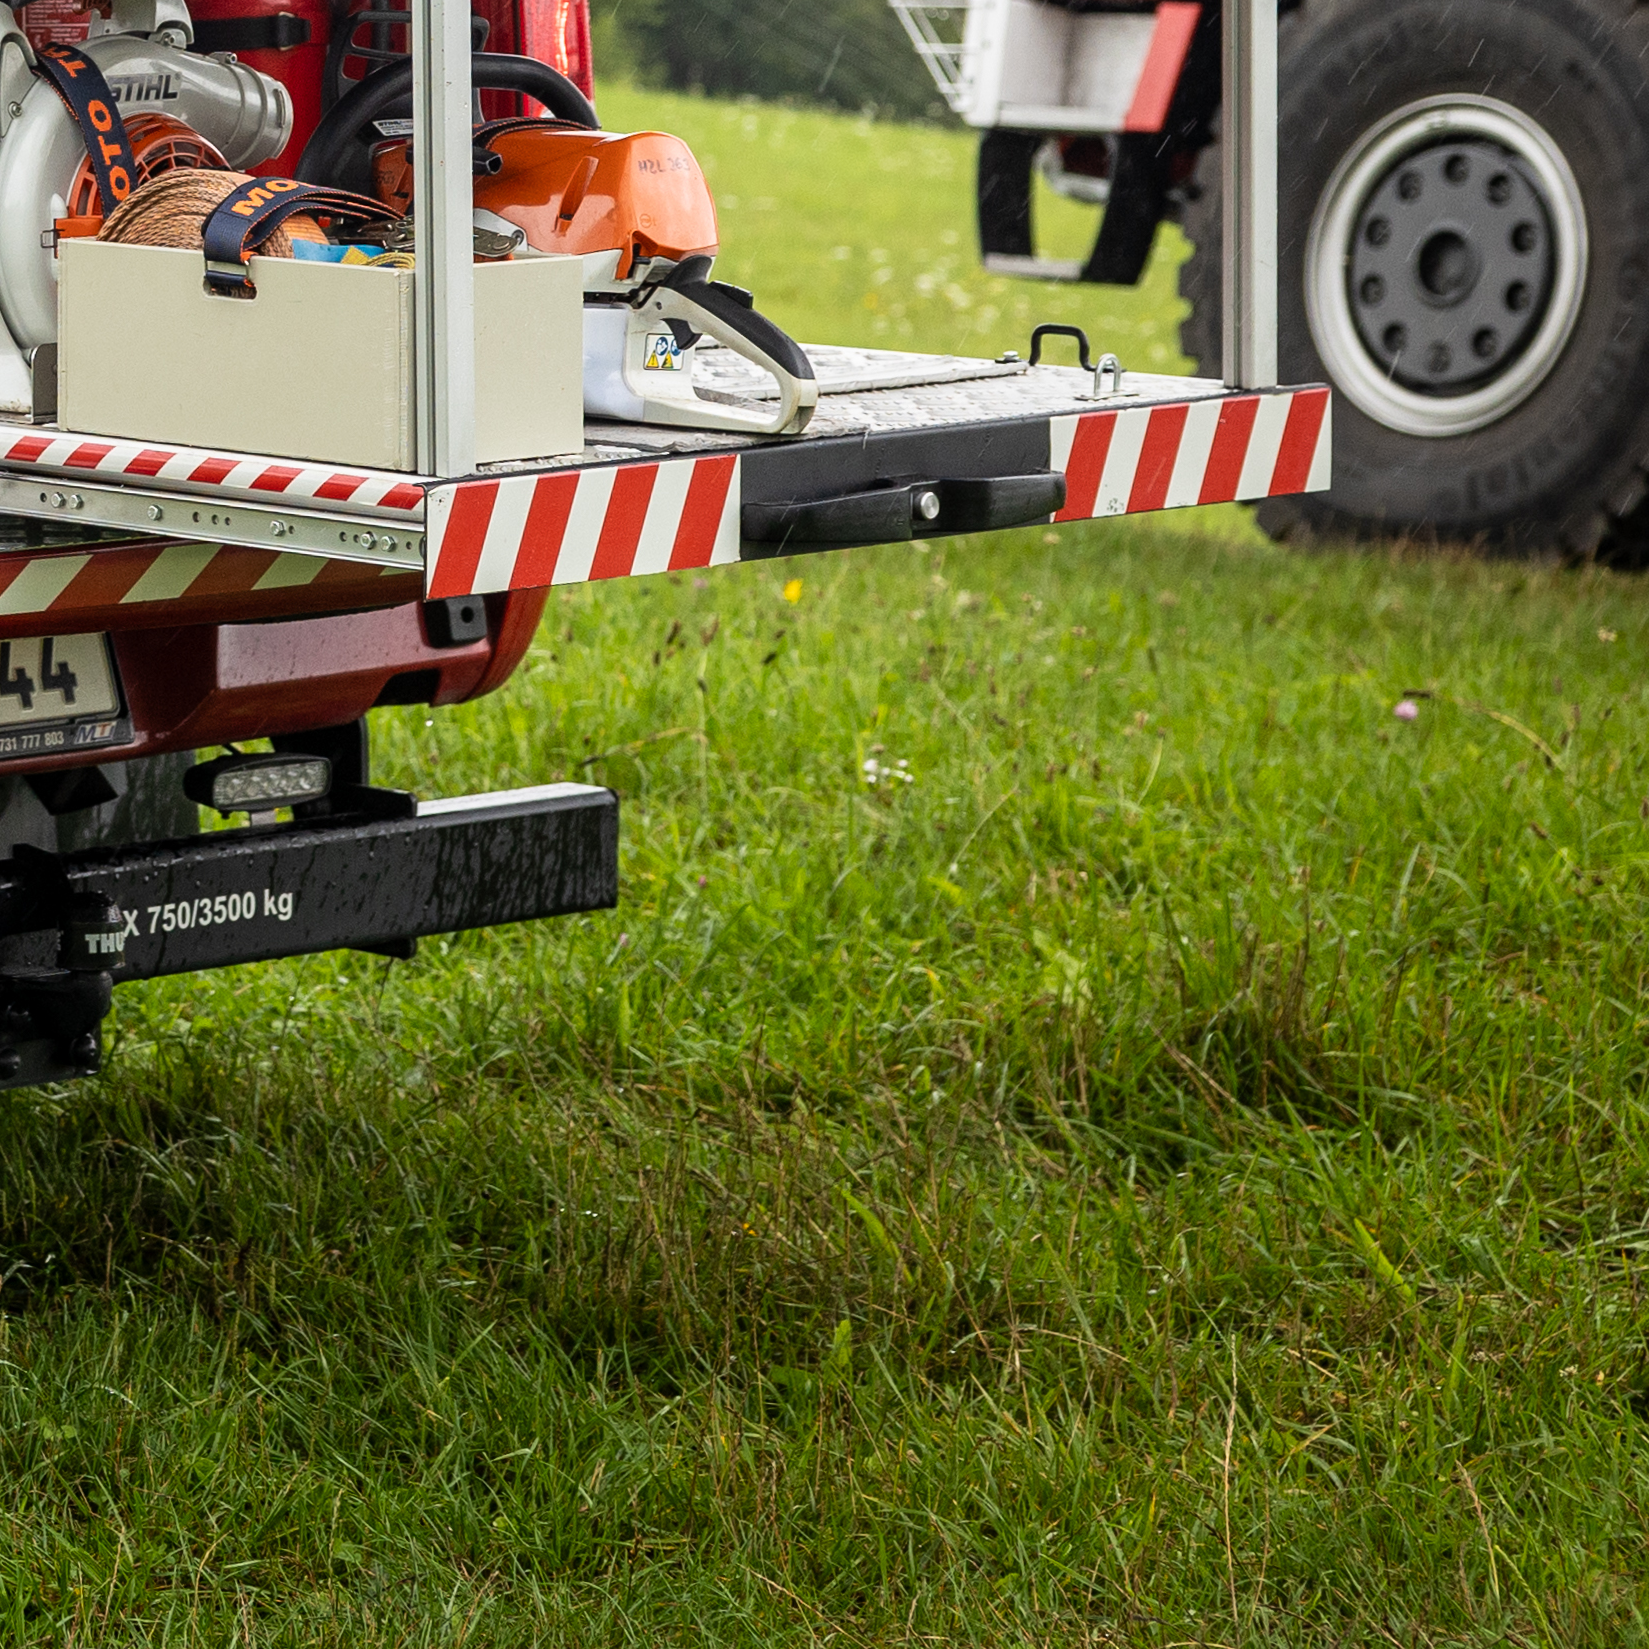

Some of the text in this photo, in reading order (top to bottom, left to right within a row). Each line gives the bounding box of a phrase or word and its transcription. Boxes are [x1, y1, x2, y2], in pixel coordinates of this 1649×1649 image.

[21, 734, 41, 750] 777
[44, 731, 65, 746] 803
[147, 891, 257, 935] 750/3500
[263, 888, 294, 922] kg
